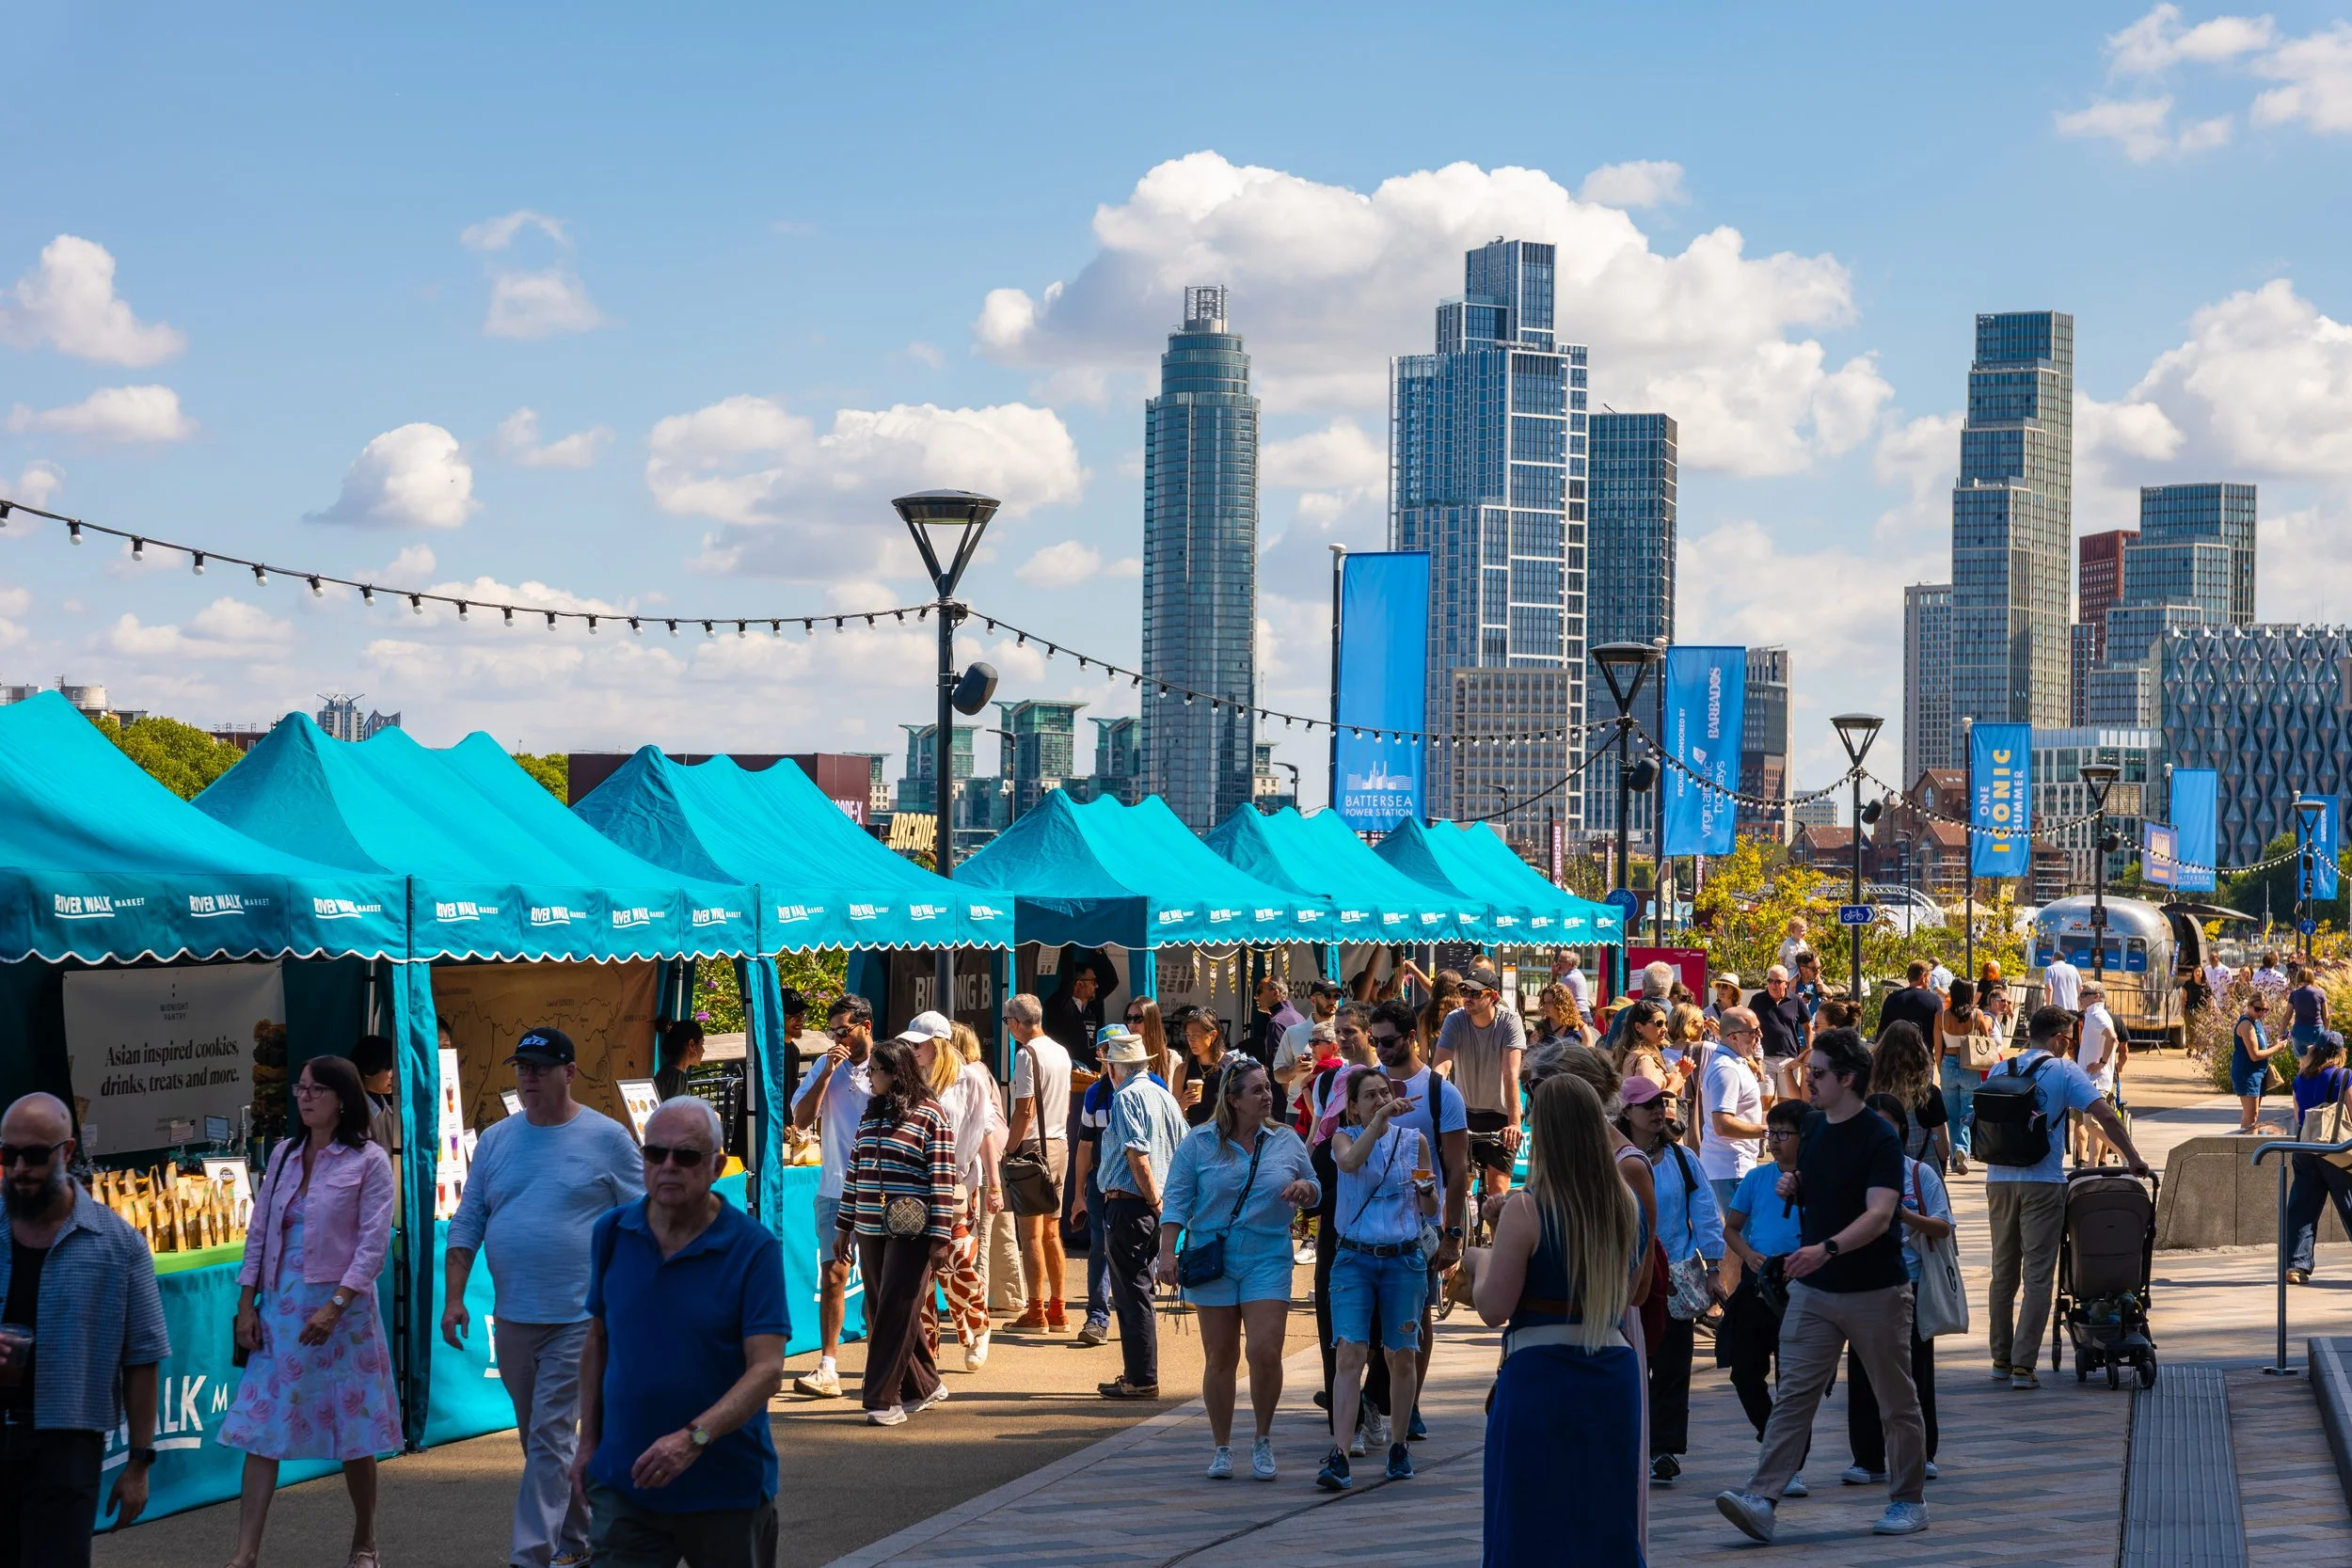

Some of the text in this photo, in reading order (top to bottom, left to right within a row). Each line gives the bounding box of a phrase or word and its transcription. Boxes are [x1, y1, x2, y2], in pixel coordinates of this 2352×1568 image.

[1678, 707, 1686, 717] BY
[1708, 666, 1722, 739] BARBADOS
[1677, 718, 1686, 763] SPONSORED
[1345, 795, 1413, 807] BATTERSEA
[1979, 785, 1990, 816] ONE
[1992, 749, 2011, 852] ICONIC
[2013, 770, 2024, 832] SUMMER
[1345, 808, 1413, 816] POWER STATION
[1700, 804, 1713, 838] virgin
[888, 812, 938, 850] ARCADE
[55, 894, 145, 914] RIVER WALK MARKET
[189, 895, 270, 914] RIVER WALK MARKET
[312, 897, 338, 913] RIVER
[436, 901, 457, 918] RIVER
[456, 901, 479, 915] WALK
[531, 906, 550, 922] RIVER
[550, 906, 570, 921] WALK
[612, 910, 631, 924] RIVER
[632, 907, 650, 921] WALK
[692, 910, 710, 924] RIVER
[710, 907, 726, 921] WALK
[160, 1002, 189, 1012] MIDNIGHT
[164, 1012, 186, 1022] PANTRY
[104, 1035, 239, 1068] Asian inspired cookies,
[100, 1066, 240, 1097] drinks, treats and more.
